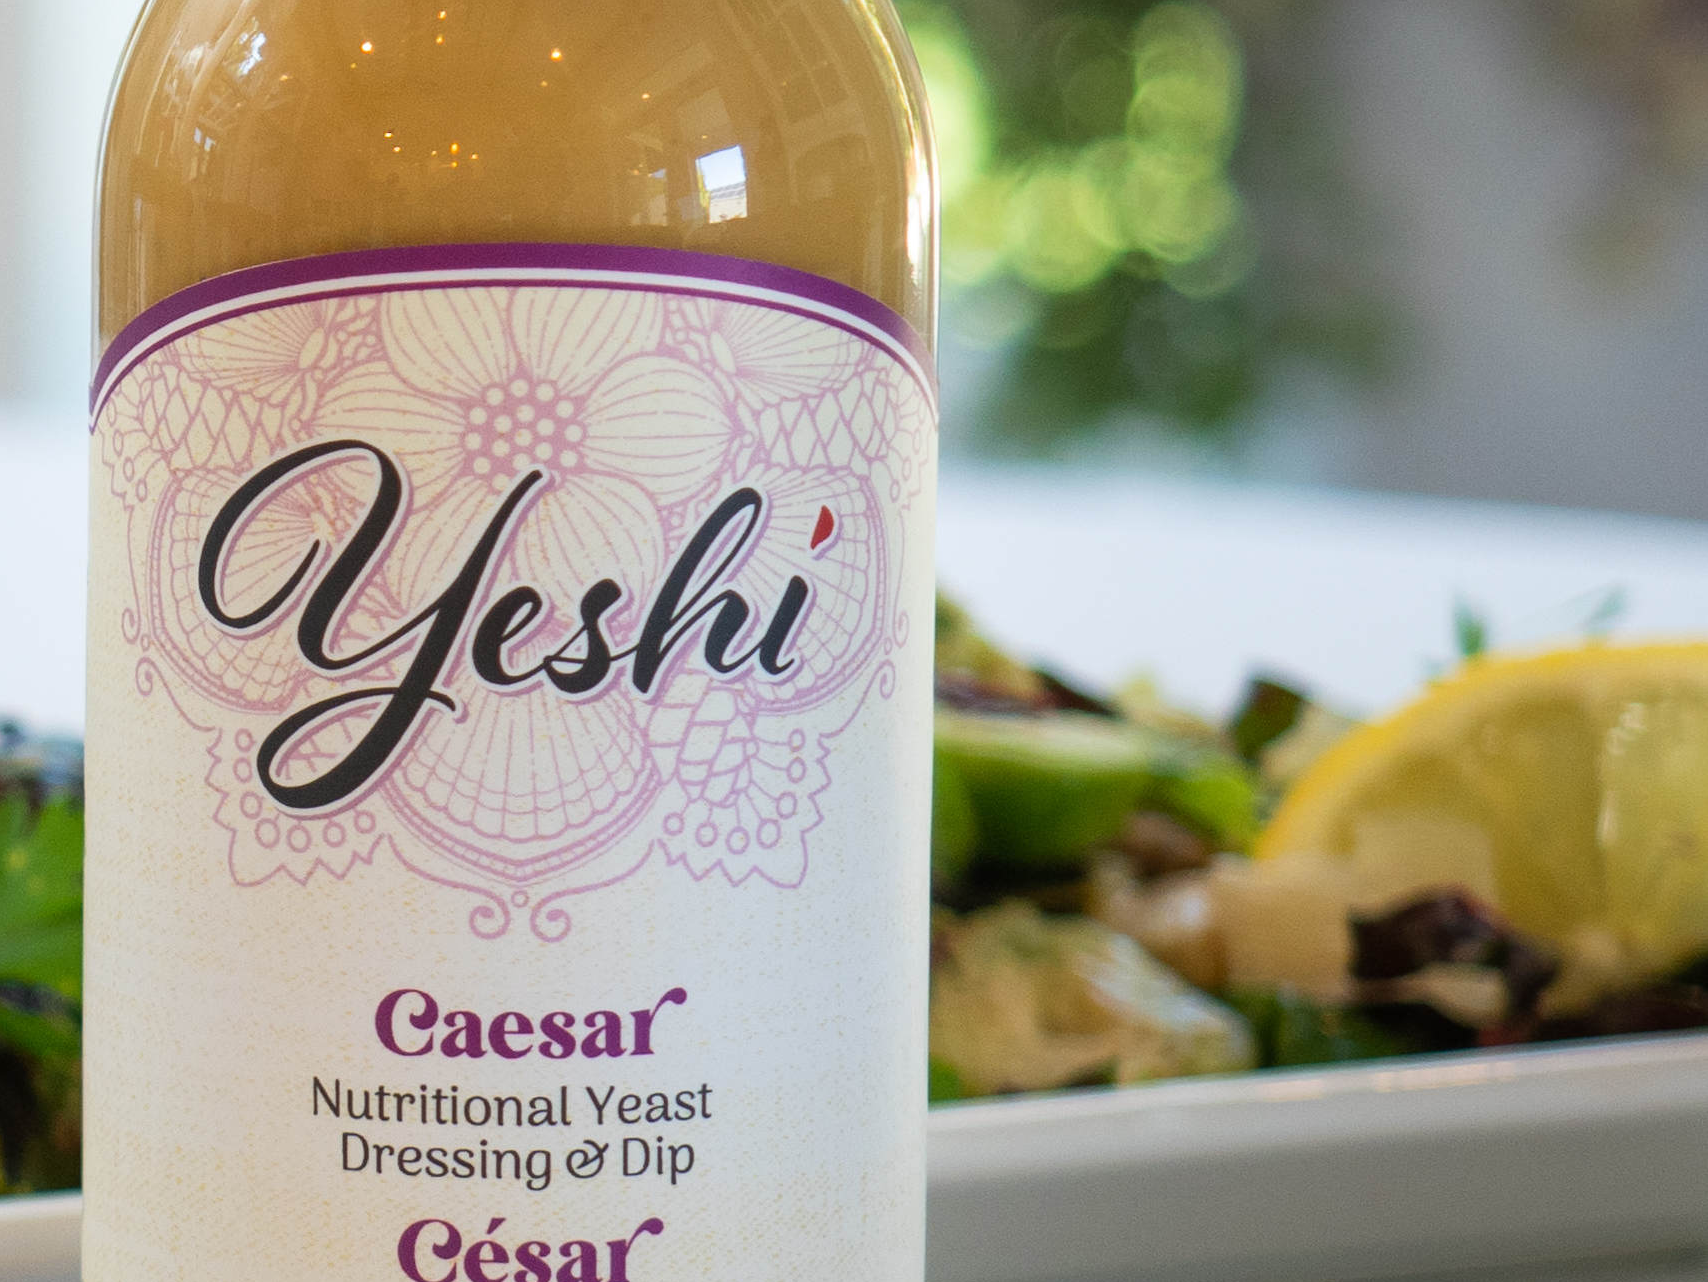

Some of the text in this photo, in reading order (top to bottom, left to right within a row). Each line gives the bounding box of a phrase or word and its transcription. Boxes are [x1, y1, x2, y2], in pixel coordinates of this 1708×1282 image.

[197, 439, 836, 811] Yeshi
[374, 986, 688, 1060] Caesar
[311, 1077, 714, 1127] Nutritional Yeast
[340, 1132, 695, 1191] Dressing & Dip
